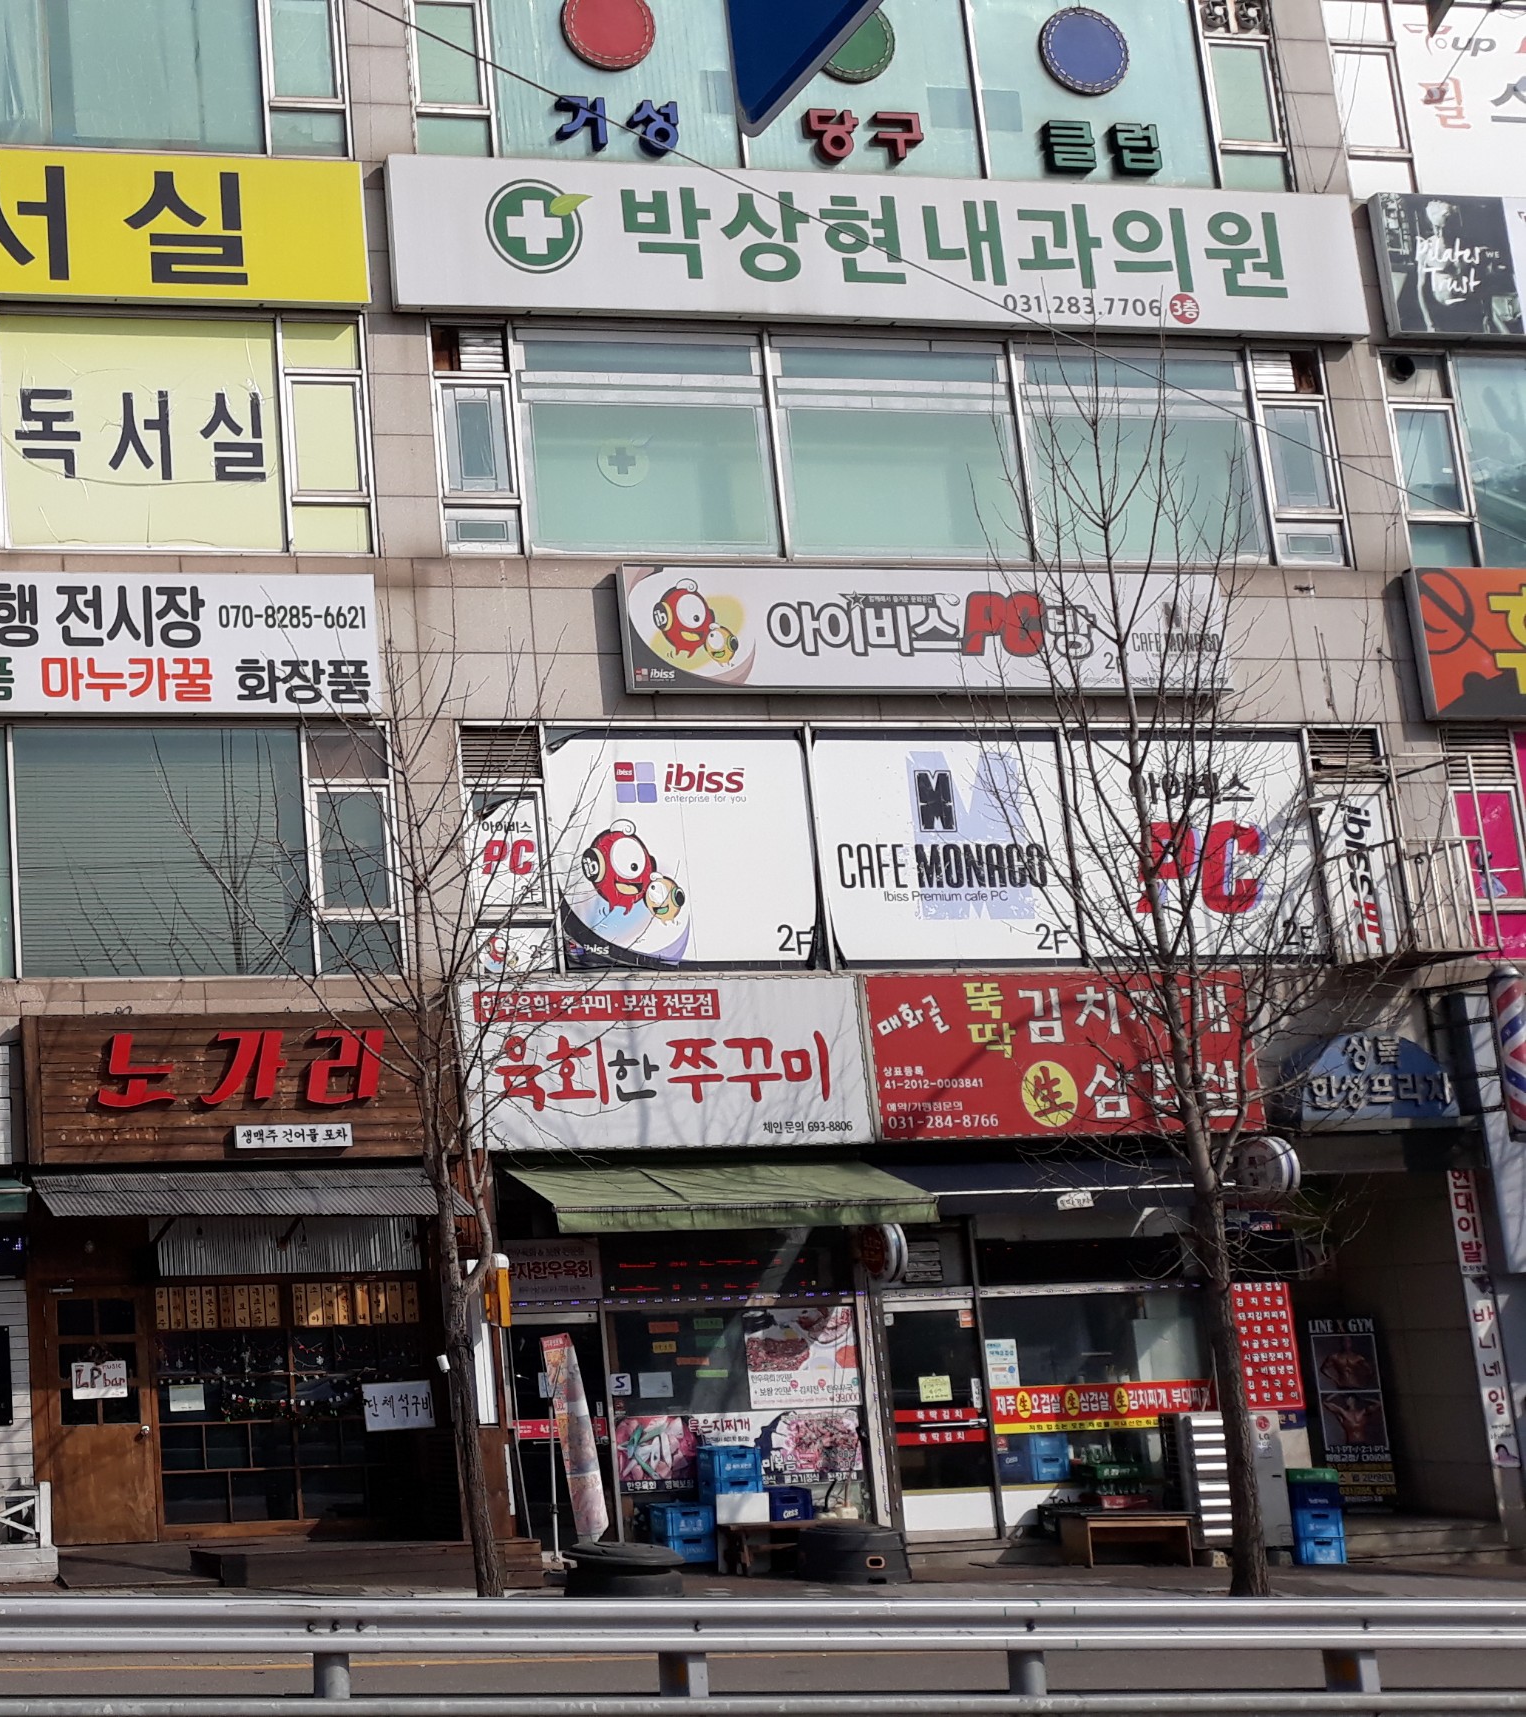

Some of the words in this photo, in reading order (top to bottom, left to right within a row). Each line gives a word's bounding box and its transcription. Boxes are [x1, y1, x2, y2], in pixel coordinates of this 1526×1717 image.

[555, 96, 679, 156] 거성
[803, 108, 925, 165] 당구
[1041, 119, 1163, 175] 클럽
[620, 187, 1289, 299] 박상현내과의원
[1415, 236, 1488, 264] Pilates
[1423, 267, 1481, 293] Trust
[1003, 293, 1162, 318] 031.283.7706
[1171, 298, 1199, 320] 3층
[56, 584, 205, 648] 전시장
[218, 604, 367, 630] 070-8285-6621
[1131, 632, 1161, 652] CAFE
[1164, 632, 1221, 653] MONACO
[41, 657, 212, 702] 마누카꿀
[235, 658, 371, 704] 화장품
[649, 669, 675, 680] ibiss
[664, 763, 745, 793] ibiss
[665, 794, 709, 804] enterprise
[714, 794, 726, 802] for
[730, 795, 746, 804] you
[482, 821, 532, 833] 아이비스
[482, 839, 536, 875] PC
[1341, 804, 1373, 896] ibiss
[837, 843, 908, 889] CAFE
[914, 843, 1048, 889] MONACO
[1136, 820, 1267, 914] PC
[912, 890, 962, 902] Premium
[964, 890, 988, 902] cafe
[990, 891, 1009, 901] PC
[776, 925, 817, 956] 2F
[1035, 923, 1071, 954] 2F
[663, 994, 712, 1016] 전문점
[877, 995, 951, 1036] 매화골
[97, 1029, 385, 1108] 노가리
[883, 1066, 924, 1077] 상표등록
[884, 1077, 984, 1090] 41-2012-0003841
[1033, 1066, 1074, 1119] 生
[763, 1121, 782, 1134] 체인
[784, 1121, 805, 1134] 문의
[808, 1120, 854, 1133] 693-8806
[888, 1113, 999, 1130] 031-284-8766
[241, 1129, 277, 1144] 생맥주
[281, 1129, 319, 1143] 건어물
[322, 1128, 348, 1142] 포차
[1308, 1319, 1334, 1333] LINE
[1348, 1318, 1374, 1332] GYM
[1473, 1305, 1506, 1415] 바니네일
[689, 1417, 751, 1434] 묵은지찌개
